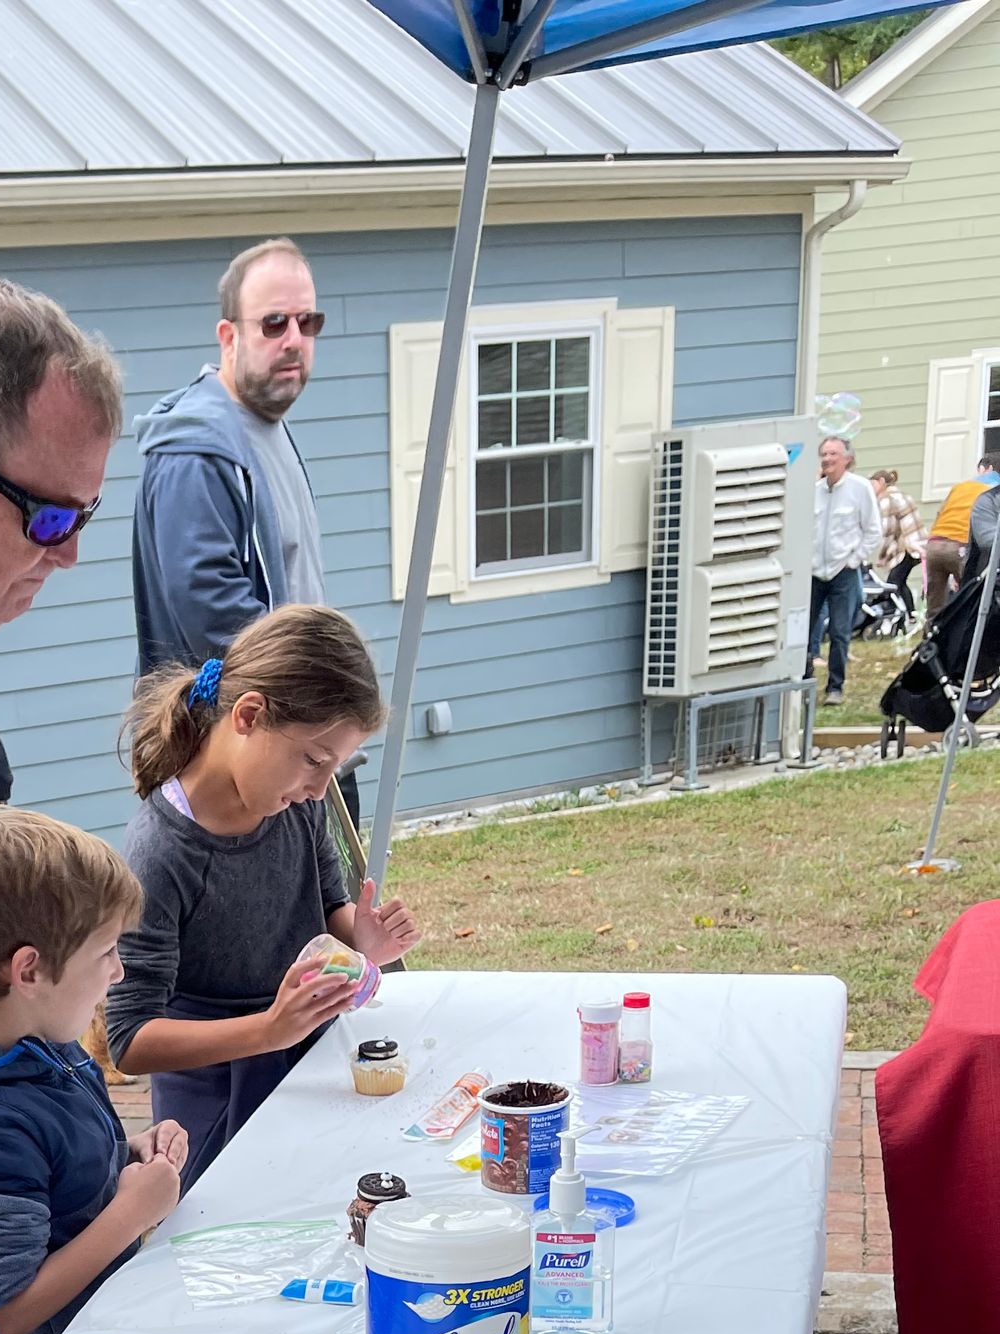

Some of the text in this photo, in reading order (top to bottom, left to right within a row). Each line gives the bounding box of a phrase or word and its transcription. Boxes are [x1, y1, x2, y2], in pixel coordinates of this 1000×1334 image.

[545, 1254, 586, 1268] Purell
[443, 1279, 524, 1305] 3X STRONGER
[470, 1301, 489, 1309] CLEAN
